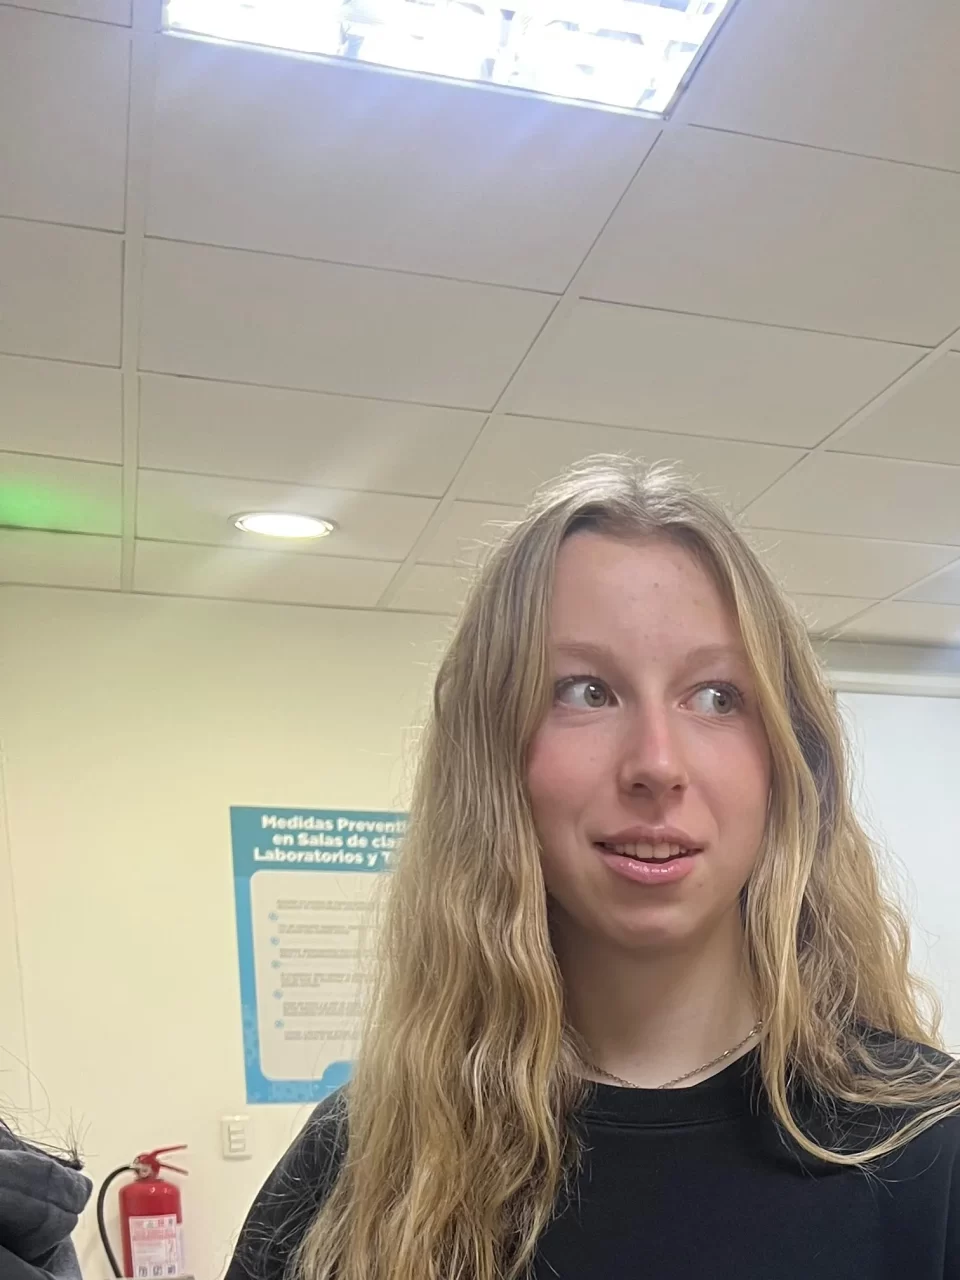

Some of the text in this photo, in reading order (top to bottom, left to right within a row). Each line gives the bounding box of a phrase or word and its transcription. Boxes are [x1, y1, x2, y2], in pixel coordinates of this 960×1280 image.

[261, 814, 334, 831] Medidas
[272, 834, 294, 846] en
[298, 832, 343, 847] Salas
[346, 834, 368, 847] de
[253, 847, 363, 863] Laboratorios
[367, 853, 377, 867] y
